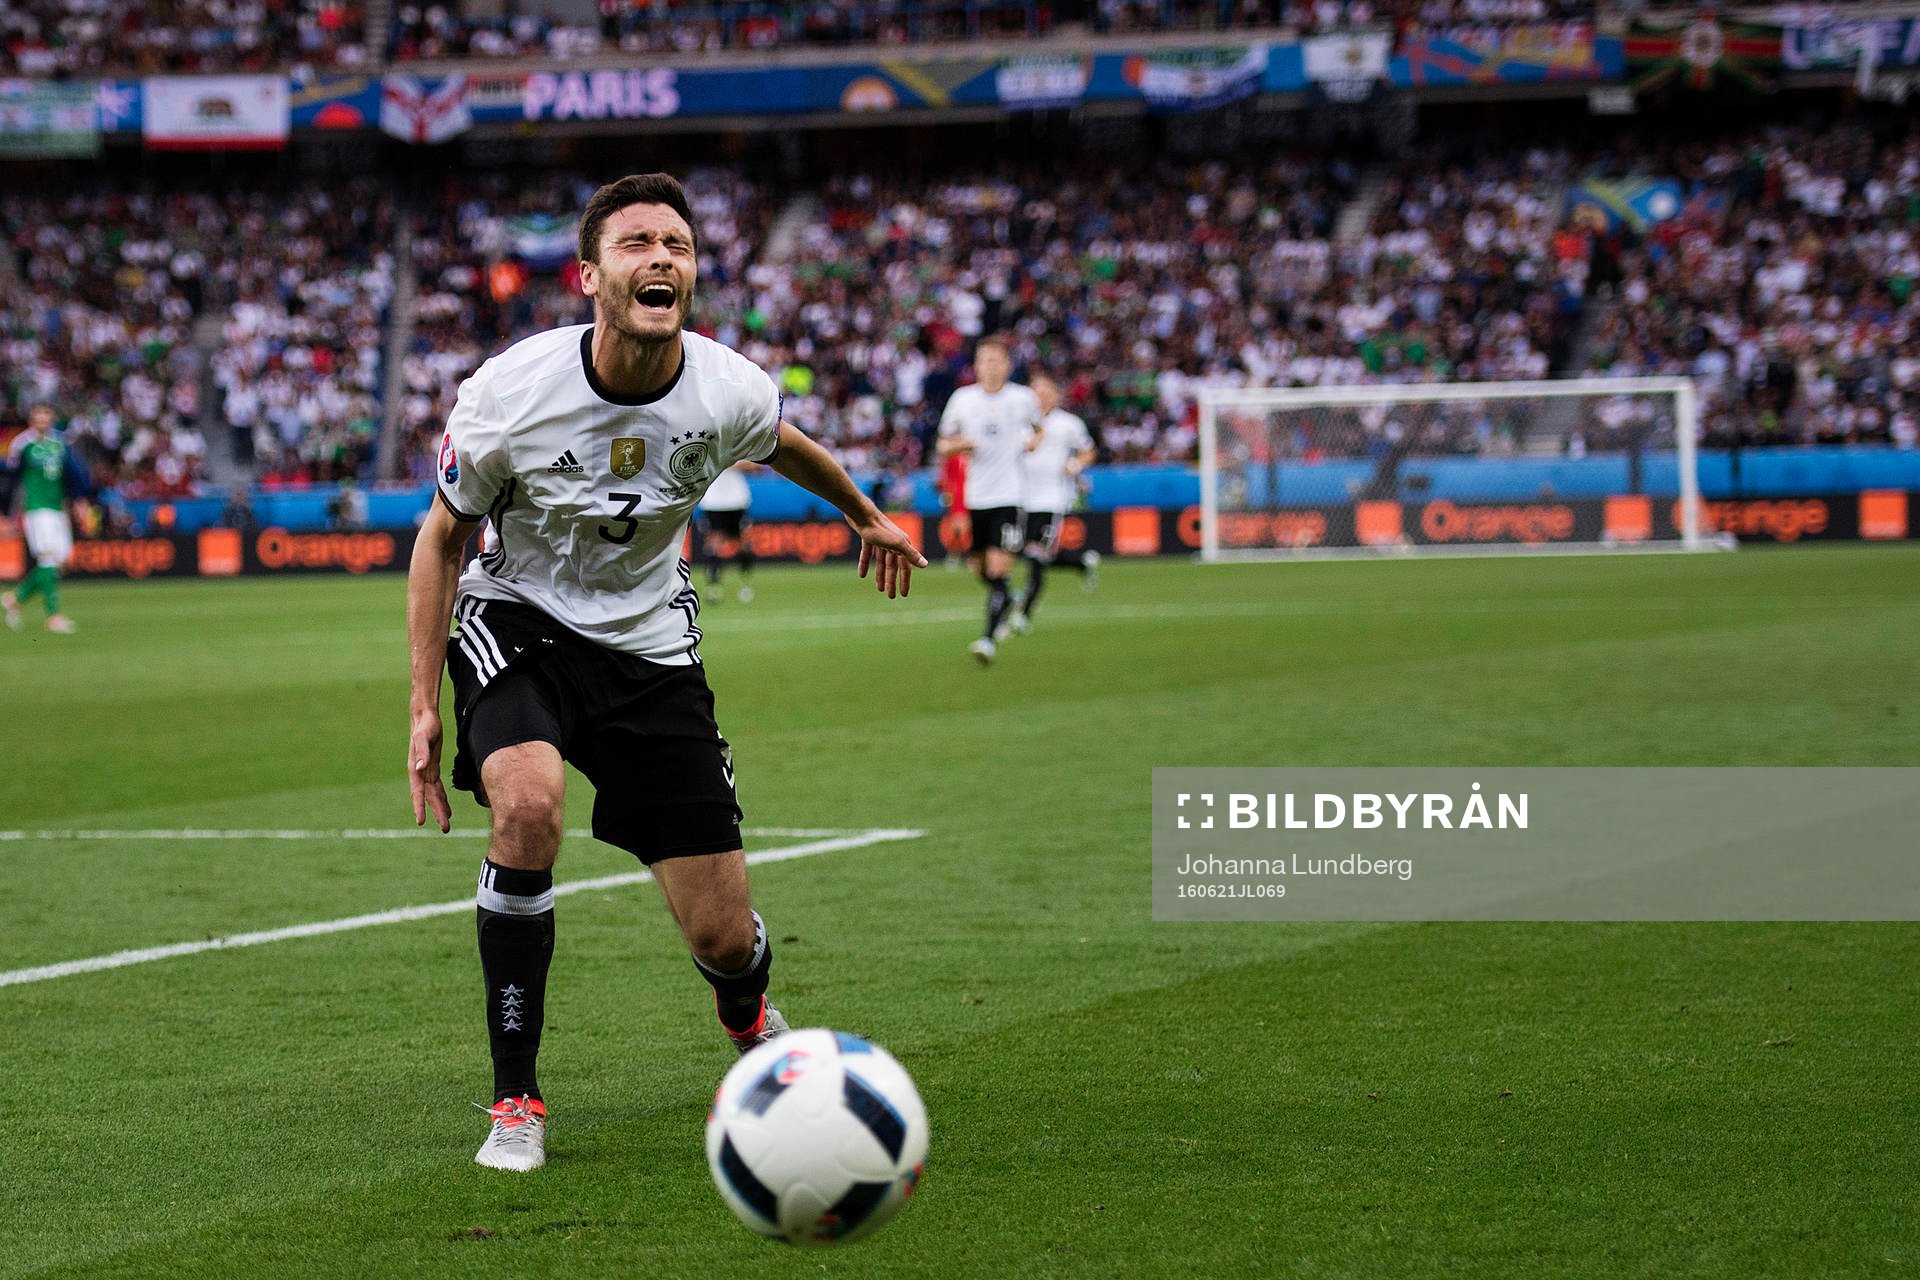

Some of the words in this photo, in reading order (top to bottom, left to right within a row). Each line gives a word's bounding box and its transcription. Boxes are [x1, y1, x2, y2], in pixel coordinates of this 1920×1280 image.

[523, 68, 680, 120] PARIS
[547, 464, 585, 474] adidas
[598, 493, 641, 544] 3
[1421, 499, 1574, 545] Orange
[68, 537, 175, 579] range
[257, 528, 396, 572] Orange
